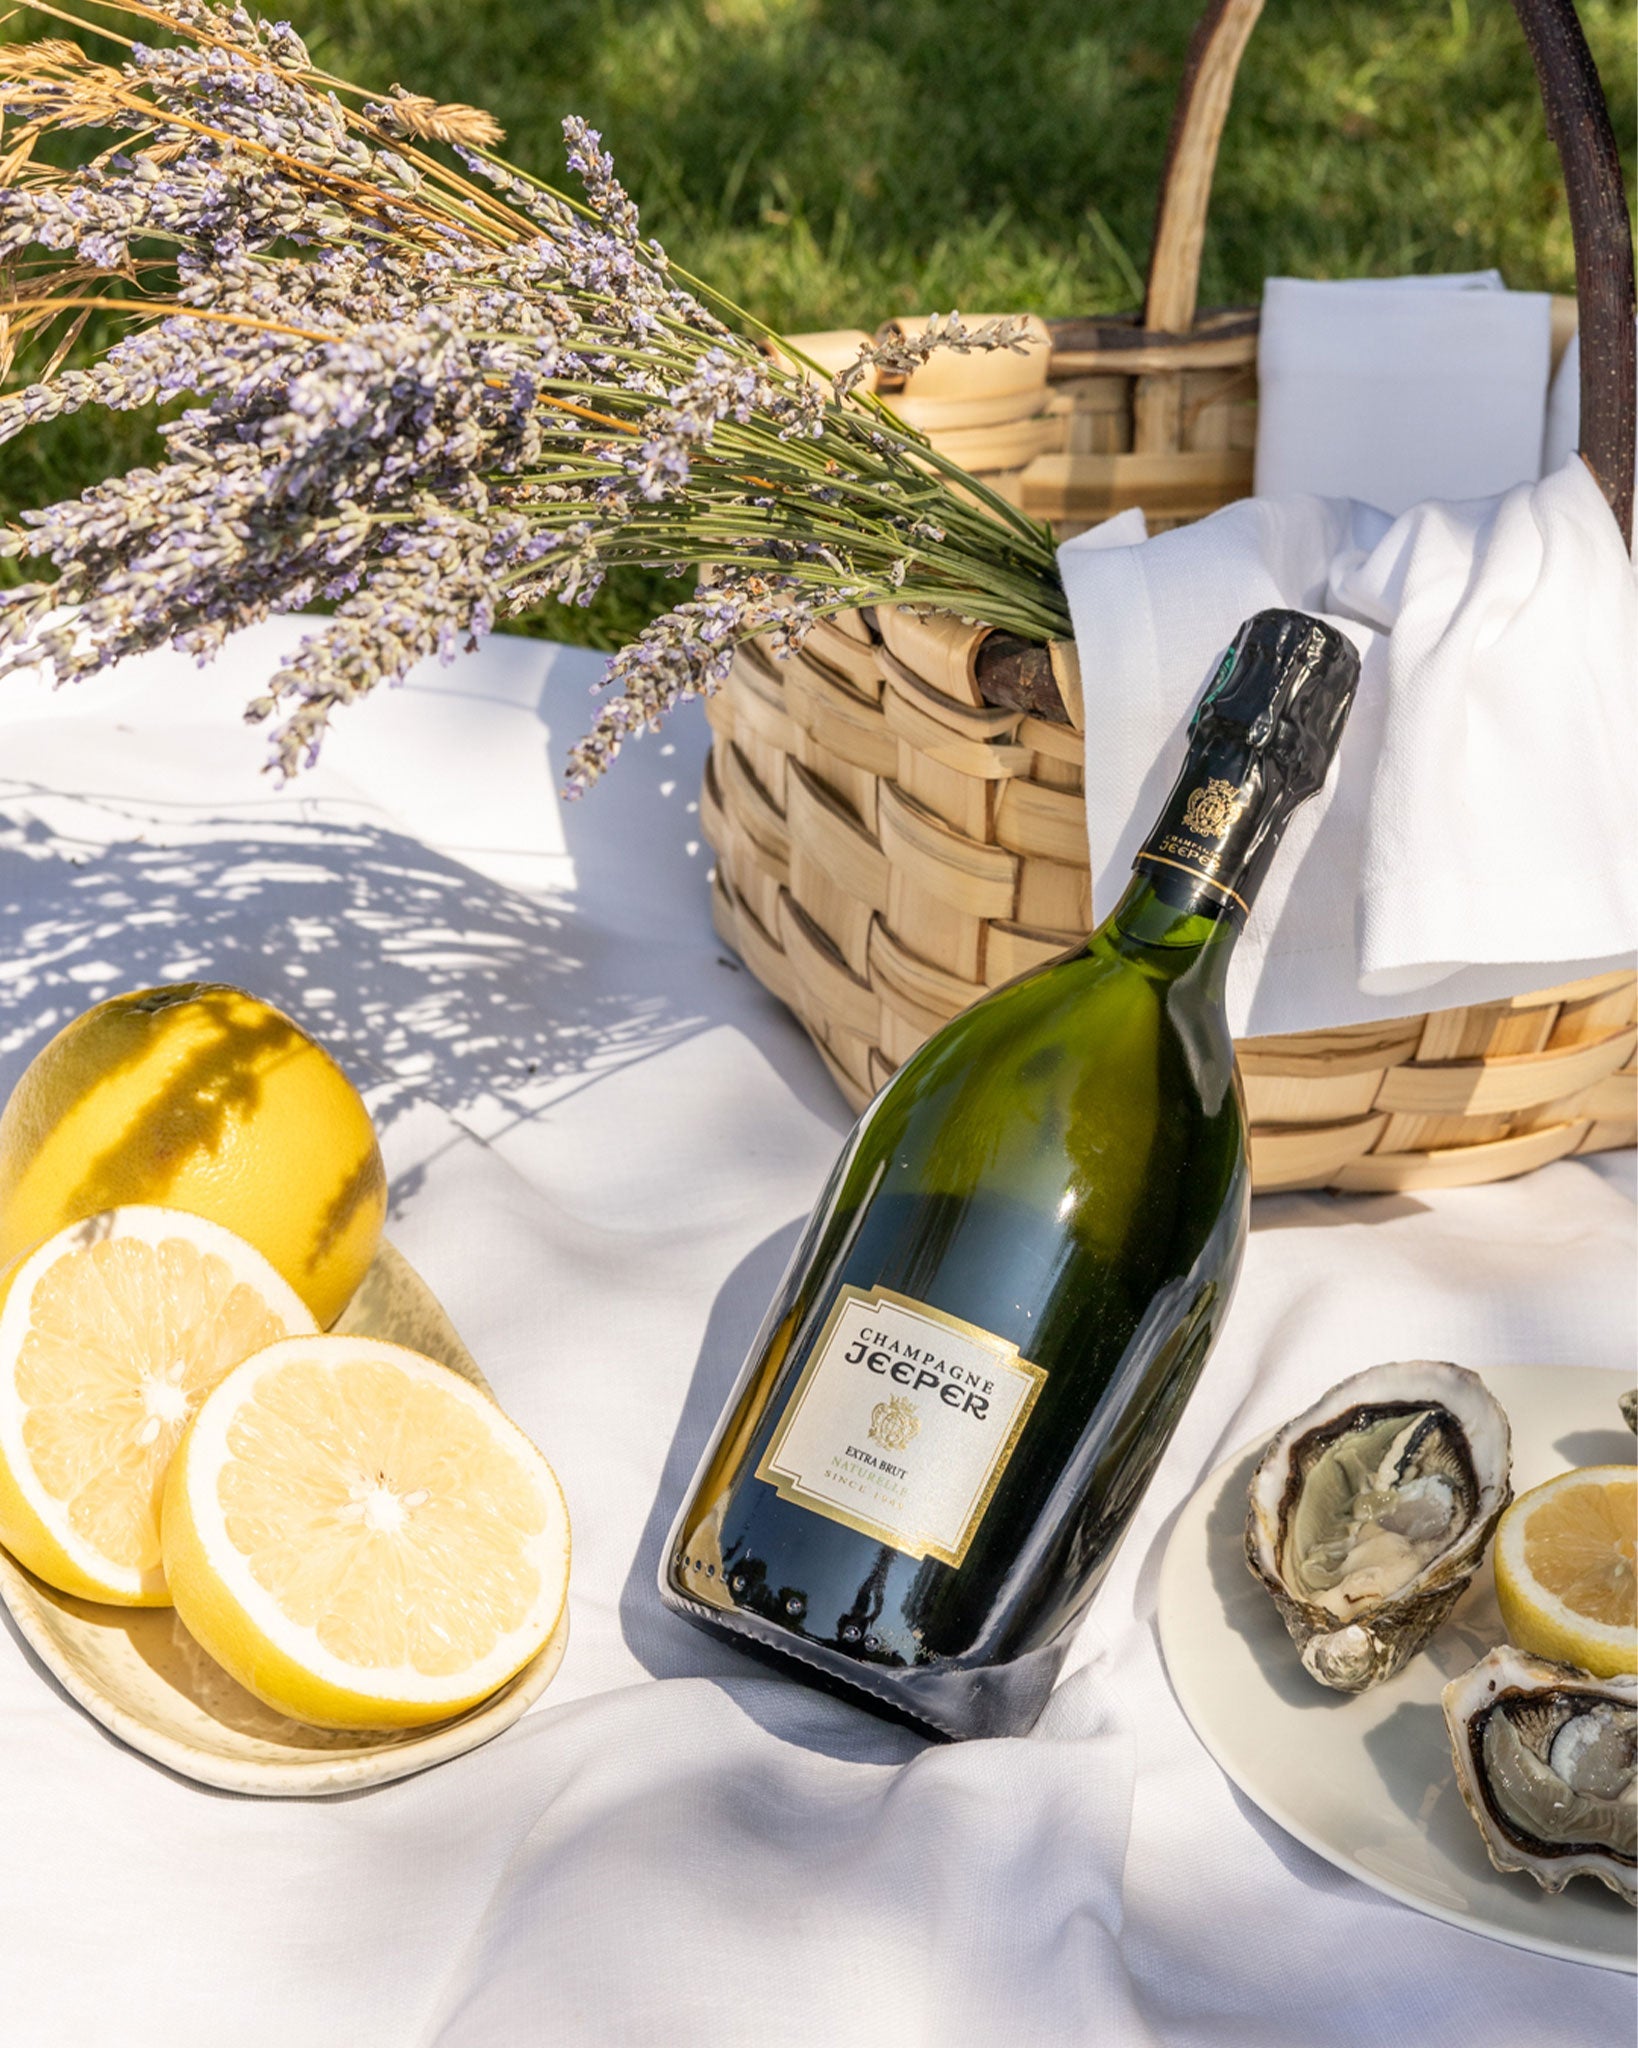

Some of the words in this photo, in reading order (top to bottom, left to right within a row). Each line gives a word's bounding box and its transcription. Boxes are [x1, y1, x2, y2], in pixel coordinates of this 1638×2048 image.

[844, 1341, 990, 1421] JEEPER
[859, 1327, 995, 1394] CHAMPAGNE
[825, 1470, 866, 1494] SINCE
[832, 1456, 909, 1497] NATURELLE
[845, 1446, 877, 1467] EXTRA
[878, 1460, 908, 1479] BRUT
